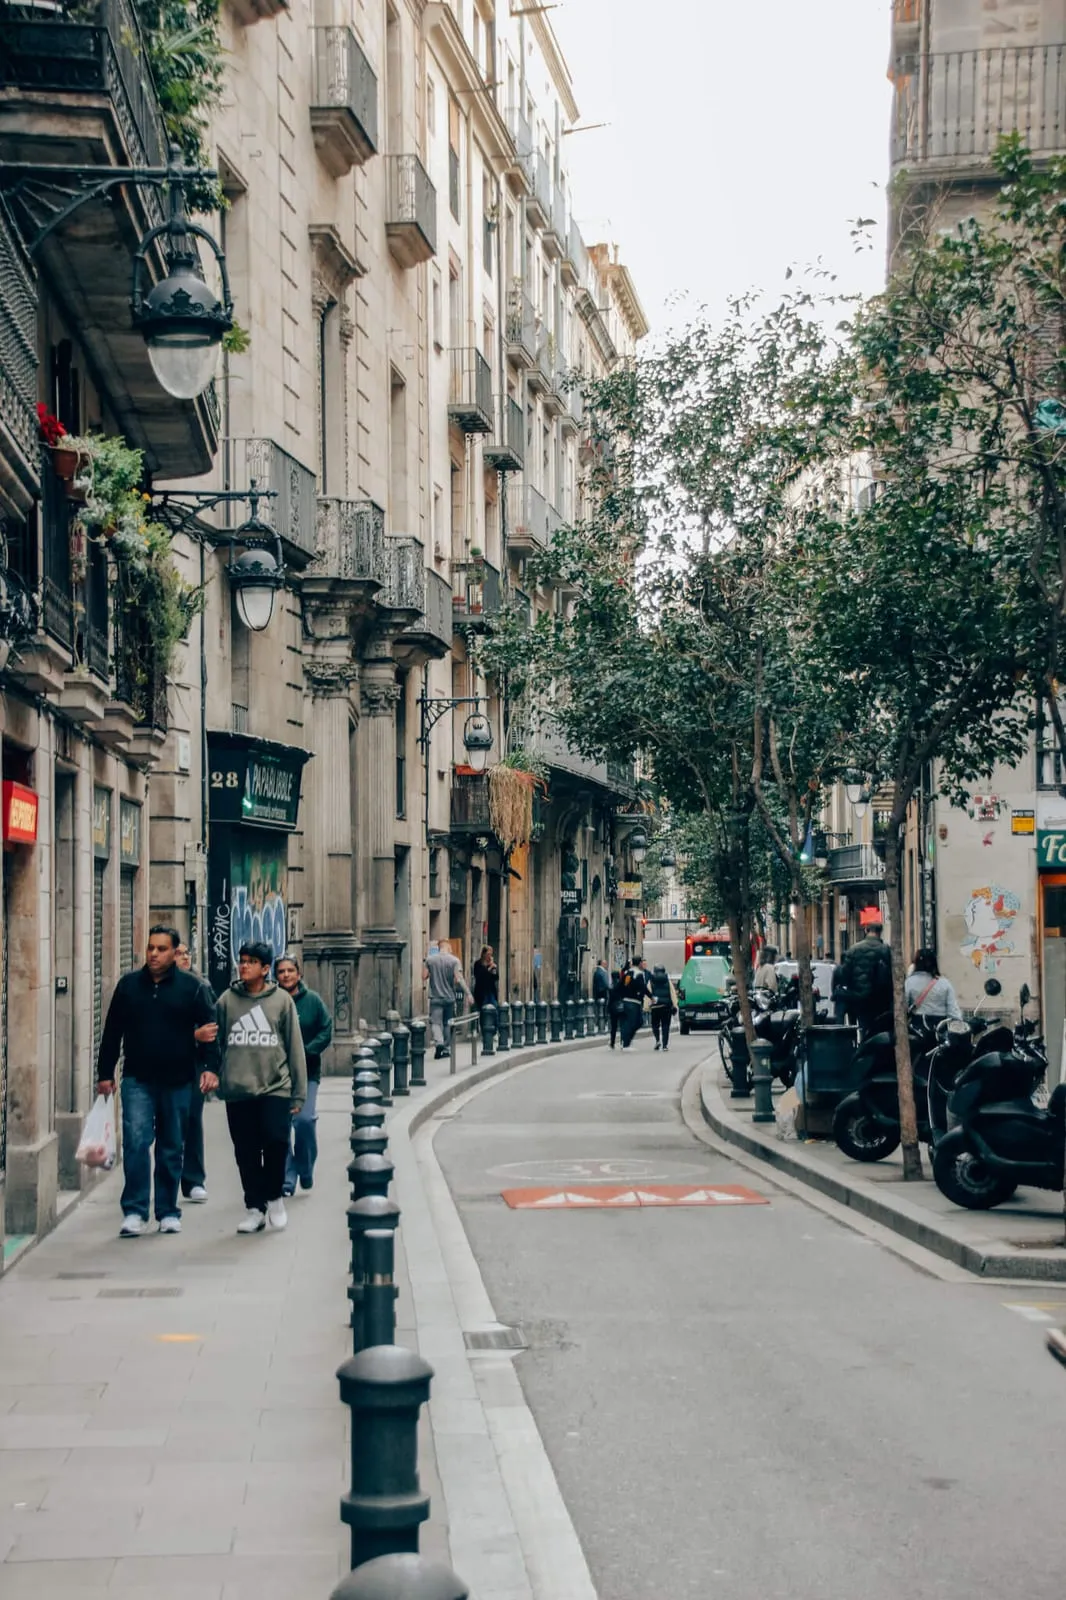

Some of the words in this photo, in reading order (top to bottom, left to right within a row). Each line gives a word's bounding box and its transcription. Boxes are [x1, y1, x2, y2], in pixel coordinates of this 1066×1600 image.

[210, 771, 239, 789] 28
[251, 763, 293, 802] PAPABUBBLE
[227, 1028, 279, 1046] adidas
